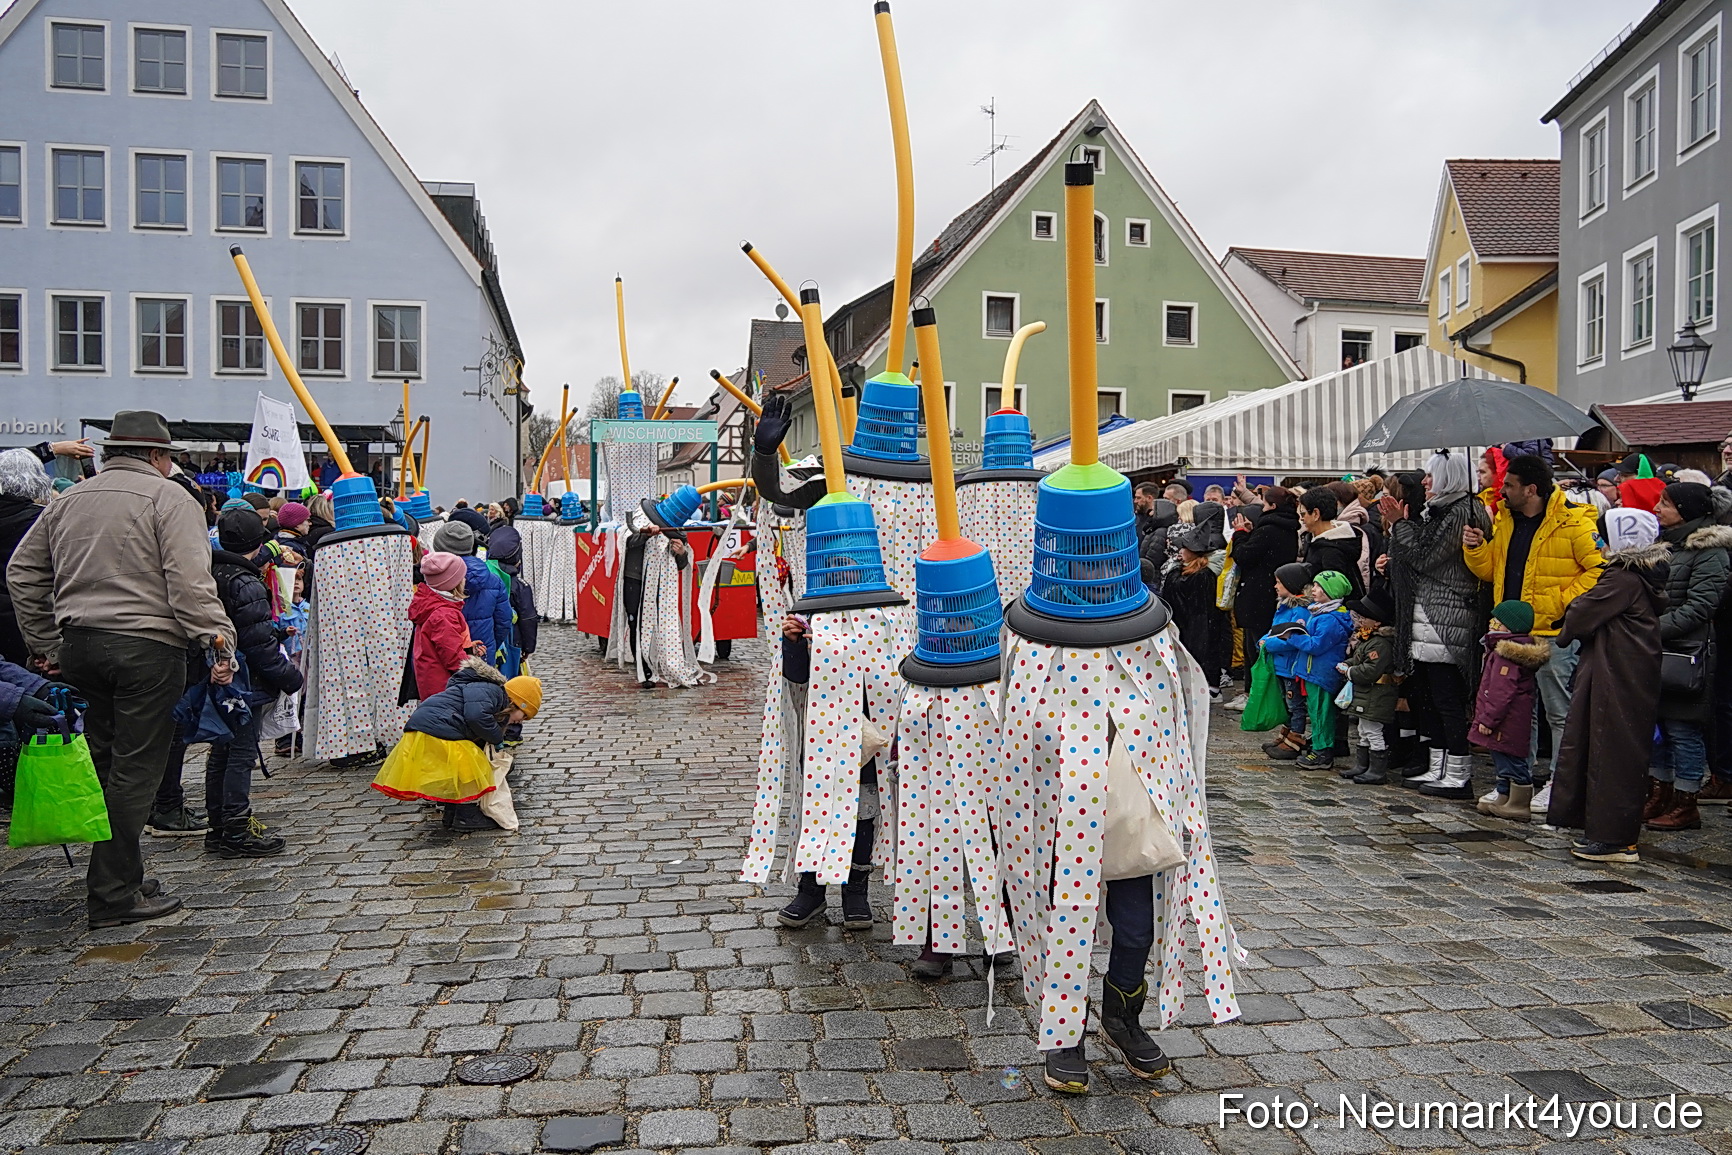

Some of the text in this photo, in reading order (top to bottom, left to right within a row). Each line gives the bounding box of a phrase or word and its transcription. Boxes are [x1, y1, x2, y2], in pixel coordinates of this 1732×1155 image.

[0, 417, 66, 434] nbank
[608, 425, 704, 440] WISCHMÖPSE
[1614, 515, 1639, 537] 12
[726, 532, 737, 549] 5
